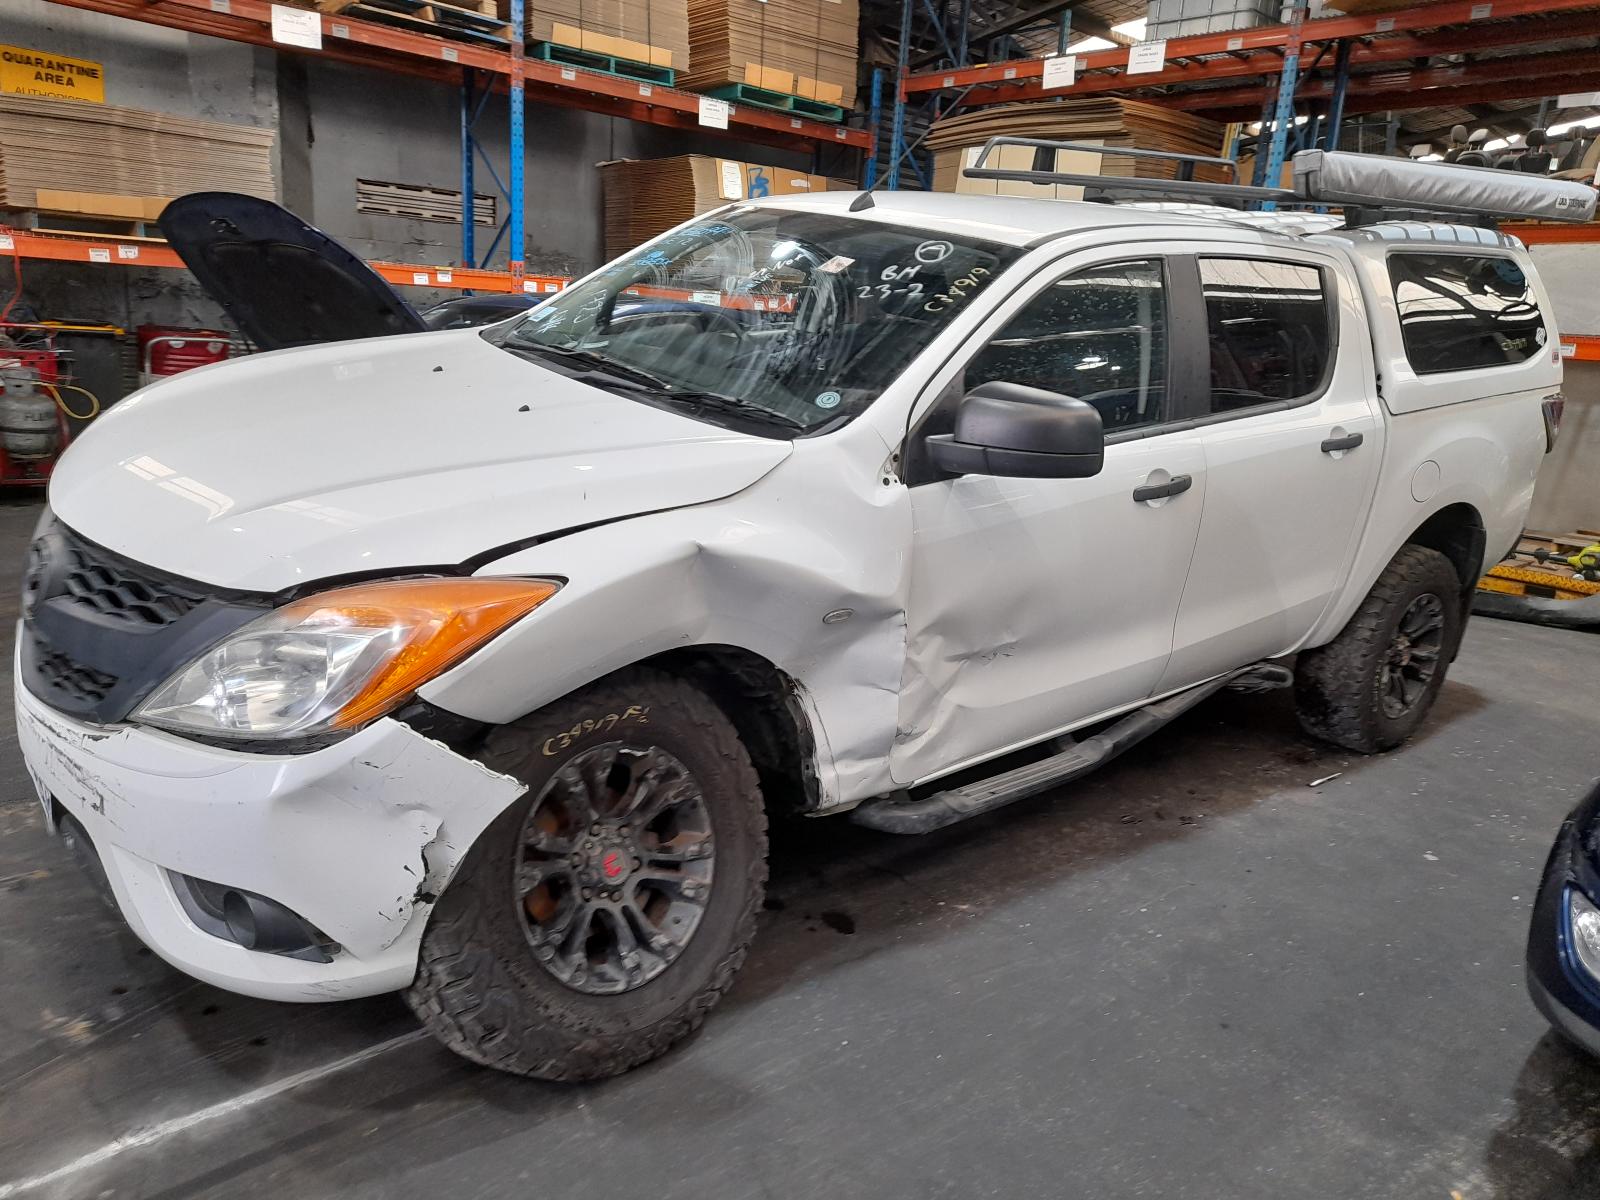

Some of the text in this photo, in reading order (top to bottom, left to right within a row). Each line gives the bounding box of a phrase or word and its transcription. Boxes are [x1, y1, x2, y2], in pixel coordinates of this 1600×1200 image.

[2, 51, 100, 79] QUARANTINE
[34, 71, 76, 88] AREA
[857, 283, 925, 299] 23-2
